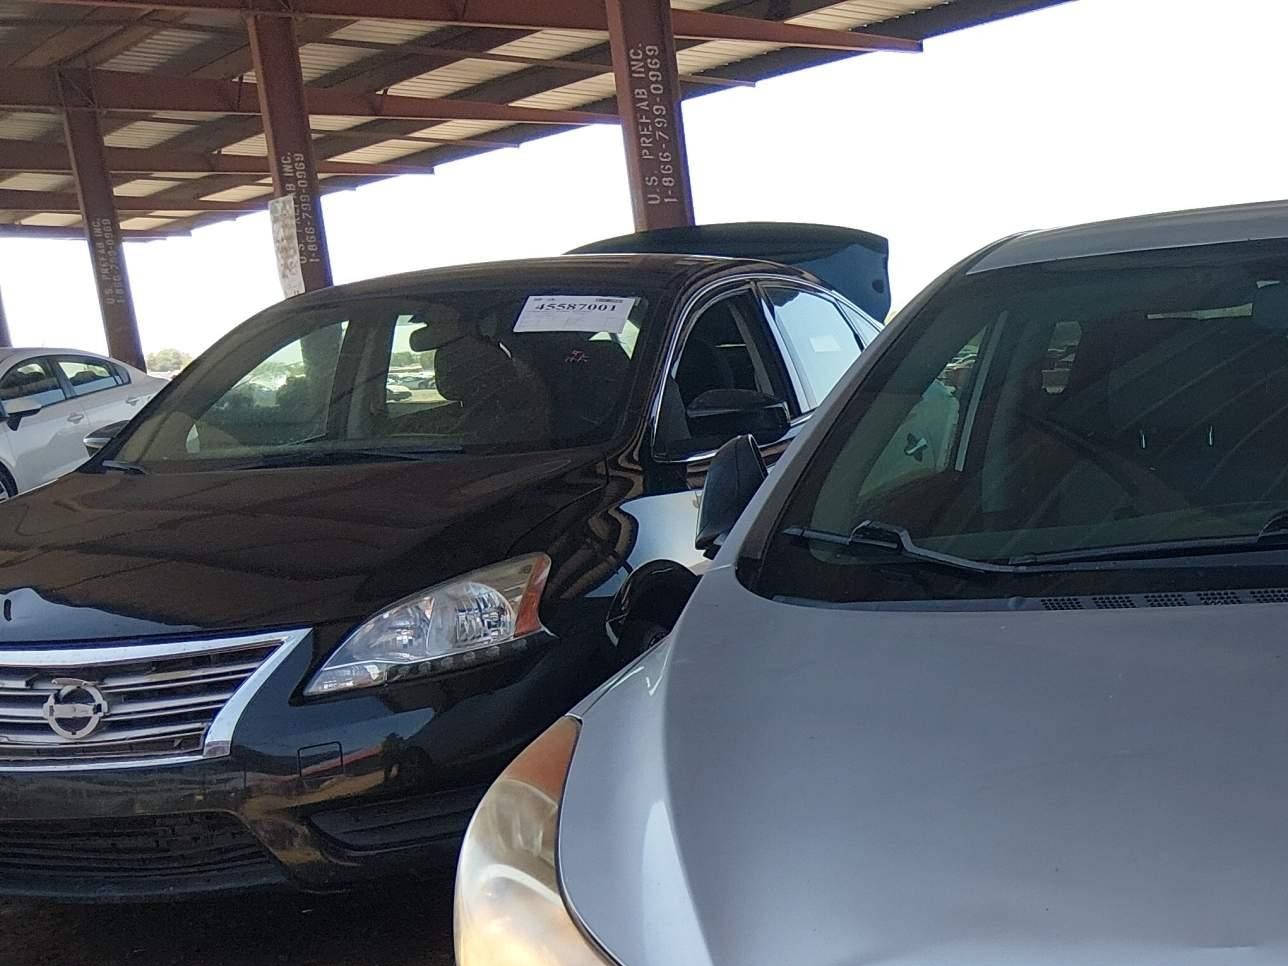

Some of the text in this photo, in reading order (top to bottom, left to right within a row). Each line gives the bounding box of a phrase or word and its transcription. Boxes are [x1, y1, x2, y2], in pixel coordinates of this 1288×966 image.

[281, 152, 294, 177] INC.
[630, 43, 661, 205] U.S. PREFAB INC.
[646, 45, 679, 204] 1-866-799-0969
[535, 303, 617, 312] 45587001
